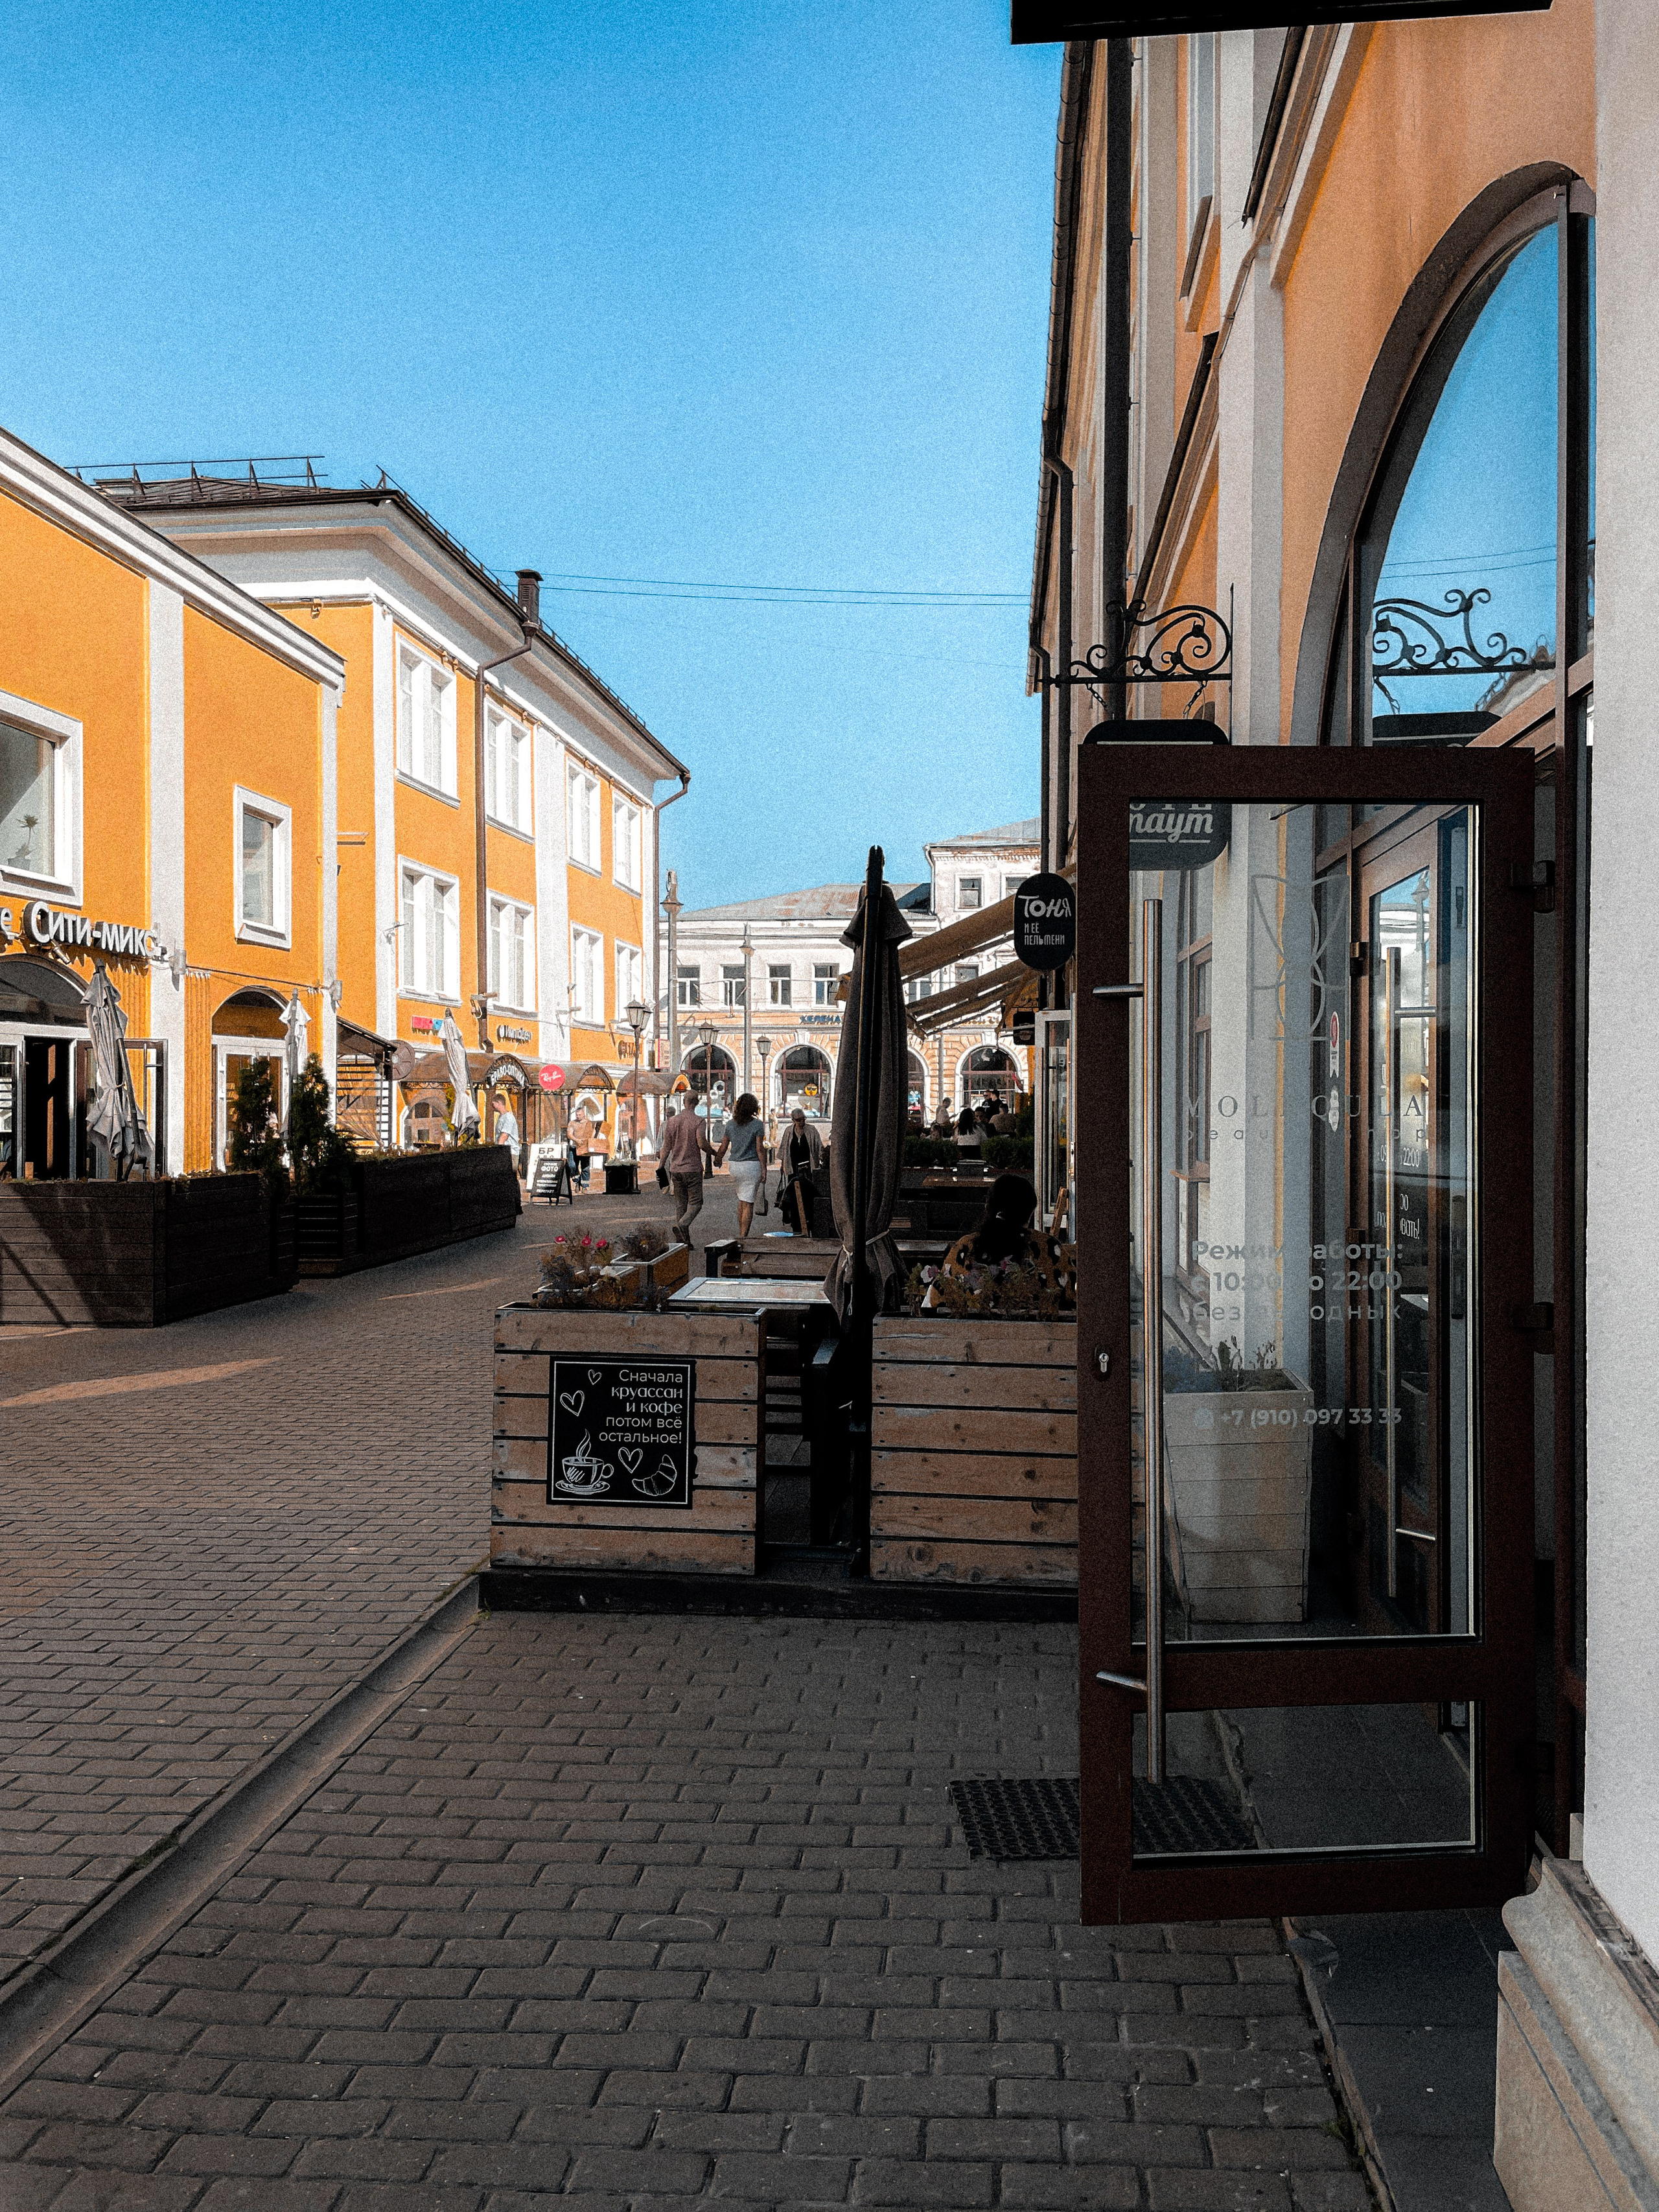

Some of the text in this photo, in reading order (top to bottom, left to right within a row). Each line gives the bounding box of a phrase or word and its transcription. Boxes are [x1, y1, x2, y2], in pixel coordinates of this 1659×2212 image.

[1024, 922, 1029, 933] И
[1024, 934, 1065, 945] ПЕЛЬМЕНИ
[491, 1064, 526, 1088] БРАВО-ОПТИКА
[540, 1071, 562, 1082] Ray-Ban
[1185, 1095, 1424, 1121] MOLQULA
[1305, 1240, 1404, 1260] аботы:
[1332, 1270, 1402, 1291] 22:00
[619, 1369, 683, 1383] Сначала
[611, 1386, 683, 1400] круассан
[625, 1401, 683, 1416] и кофе
[605, 1416, 682, 1428] потом всё
[1220, 1408, 1402, 1428] +7 (910) 097 33 33
[599, 1431, 682, 1444] остальное!
